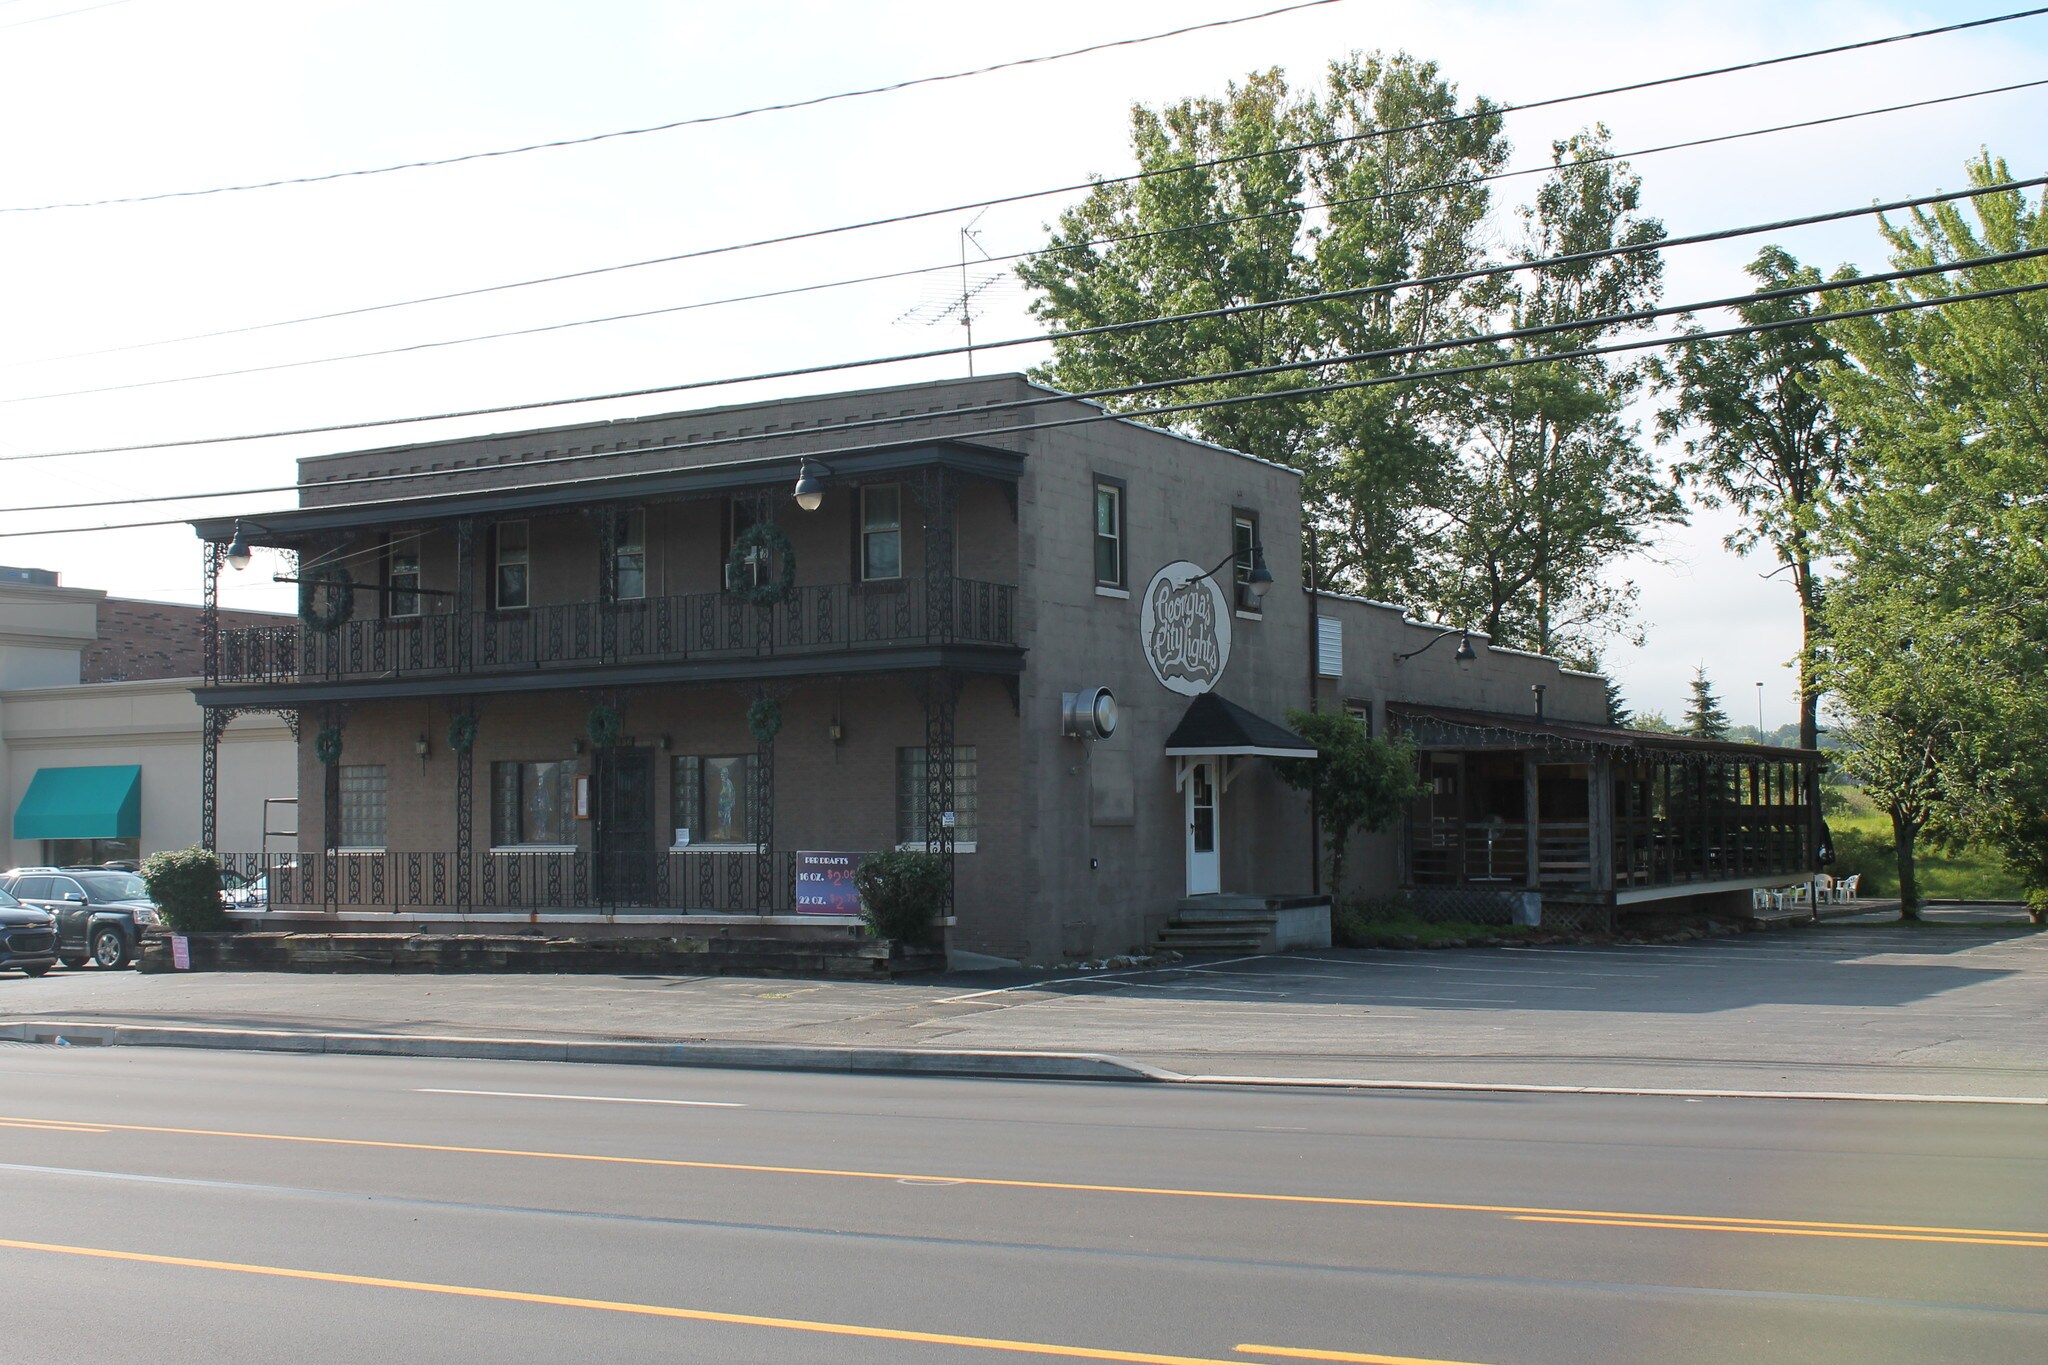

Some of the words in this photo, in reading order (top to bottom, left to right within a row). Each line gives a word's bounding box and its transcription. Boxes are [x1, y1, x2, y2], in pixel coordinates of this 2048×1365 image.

[1156, 583, 1211, 628] Georgia's
[1154, 619, 1183, 671] City
[1183, 618, 1217, 674] Lights
[820, 857, 849, 865] DRAFTS
[799, 872, 809, 881] 16
[809, 872, 825, 882] OZ.
[799, 895, 810, 904] 22
[811, 896, 827, 905] OZ.
